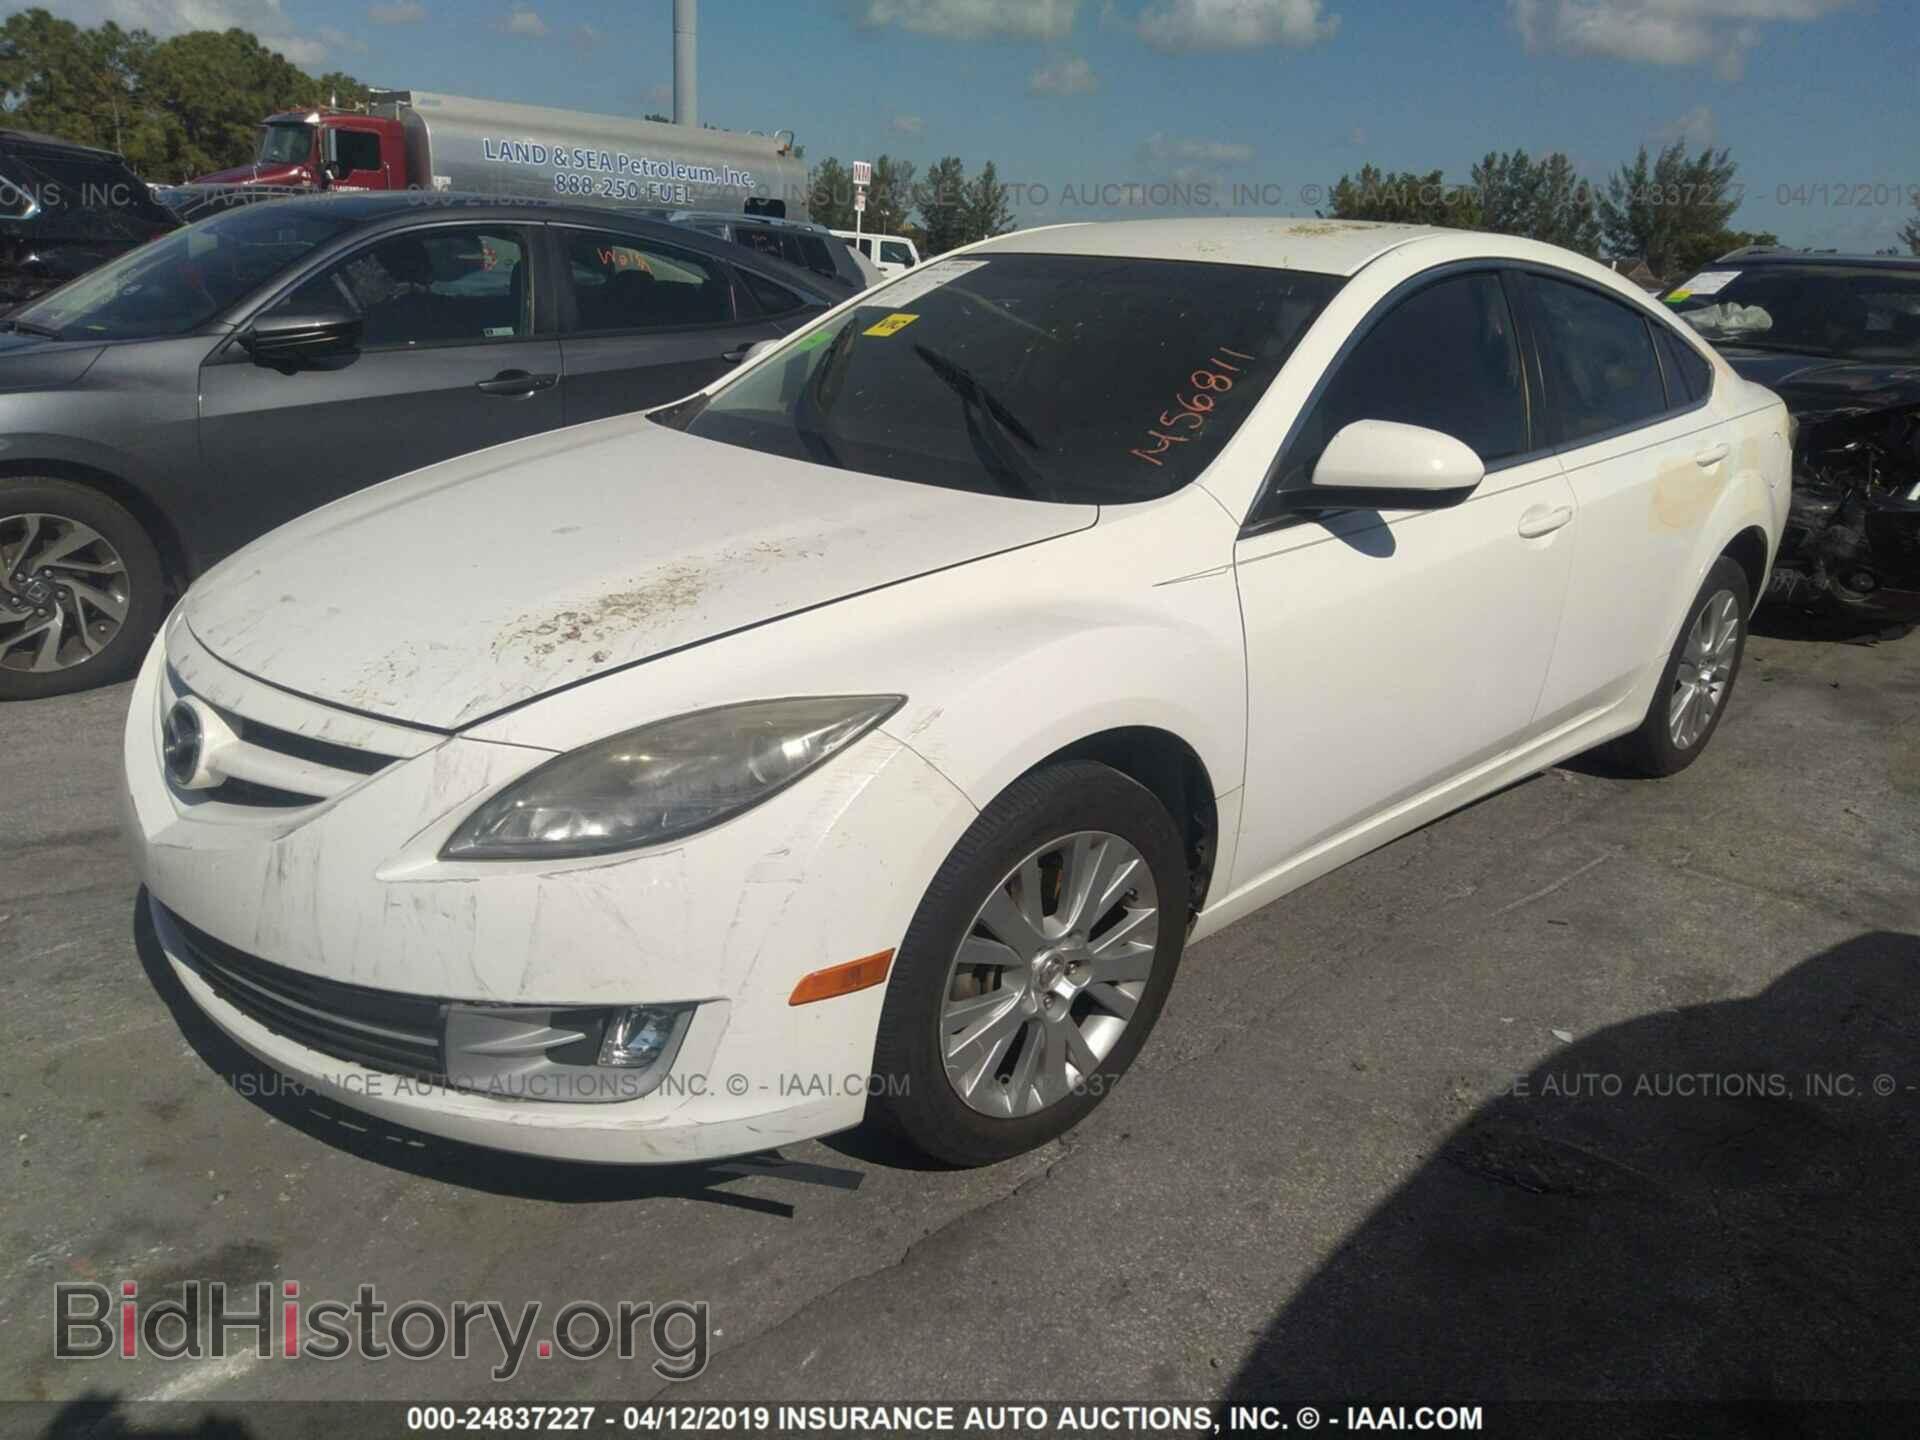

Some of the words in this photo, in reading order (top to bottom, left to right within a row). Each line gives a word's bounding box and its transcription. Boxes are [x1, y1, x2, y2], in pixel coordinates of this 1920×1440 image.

[483, 138, 547, 165] LAND
[553, 147, 567, 167] &
[573, 149, 613, 172] SEA
[722, 165, 756, 188] Inc.
